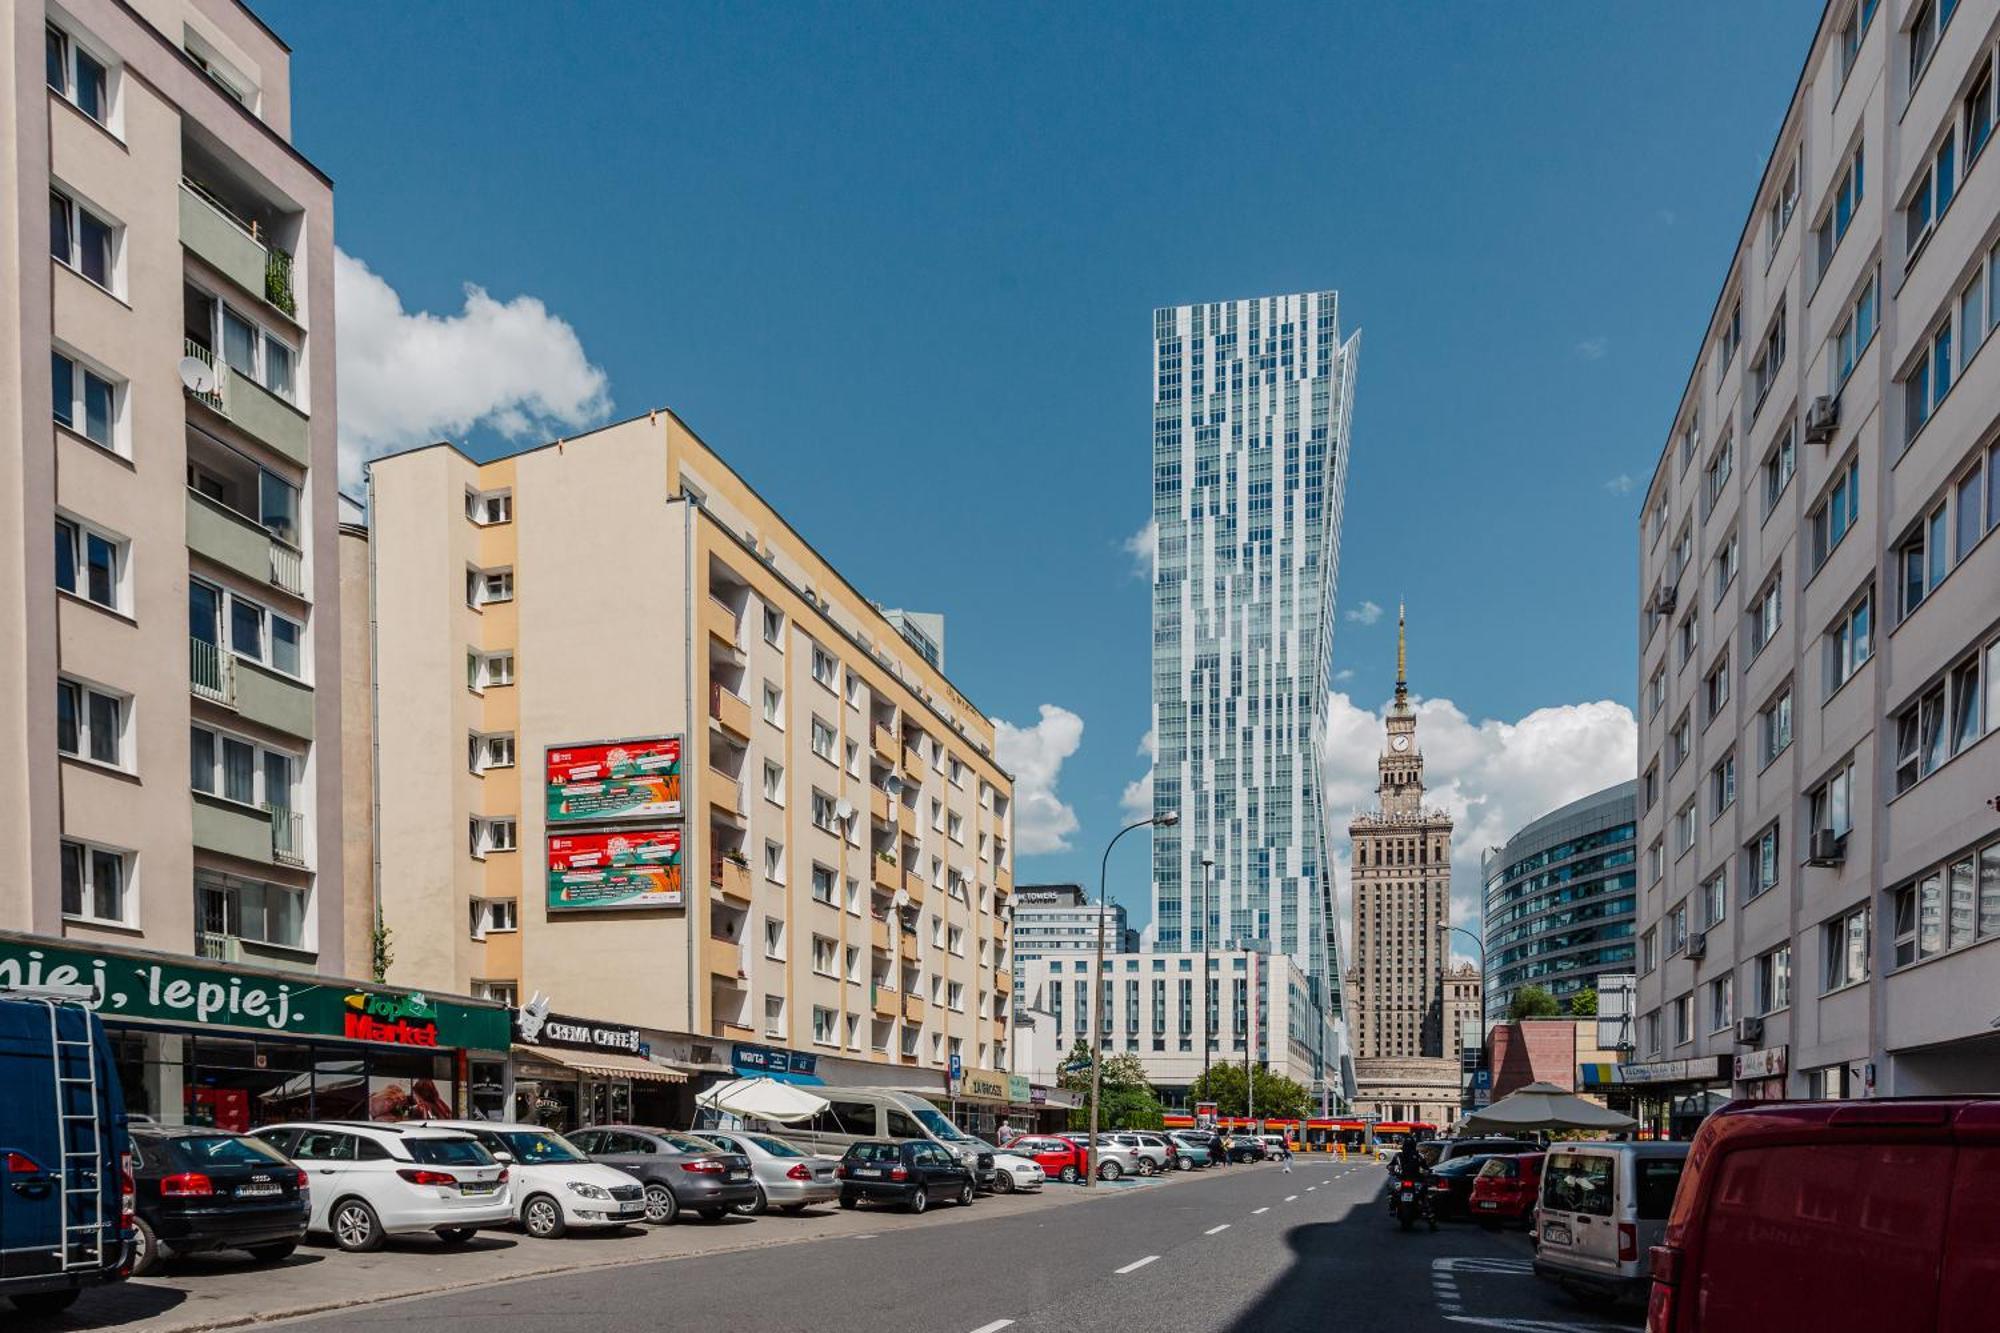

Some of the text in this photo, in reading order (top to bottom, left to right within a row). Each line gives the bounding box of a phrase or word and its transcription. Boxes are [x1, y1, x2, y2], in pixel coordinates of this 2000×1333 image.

[149, 966, 305, 1029] lepiej.
[345, 1012, 437, 1047] Market
[546, 1021, 592, 1043] CREMA
[952, 1056, 959, 1072] P
[1478, 1071, 1488, 1084] P
